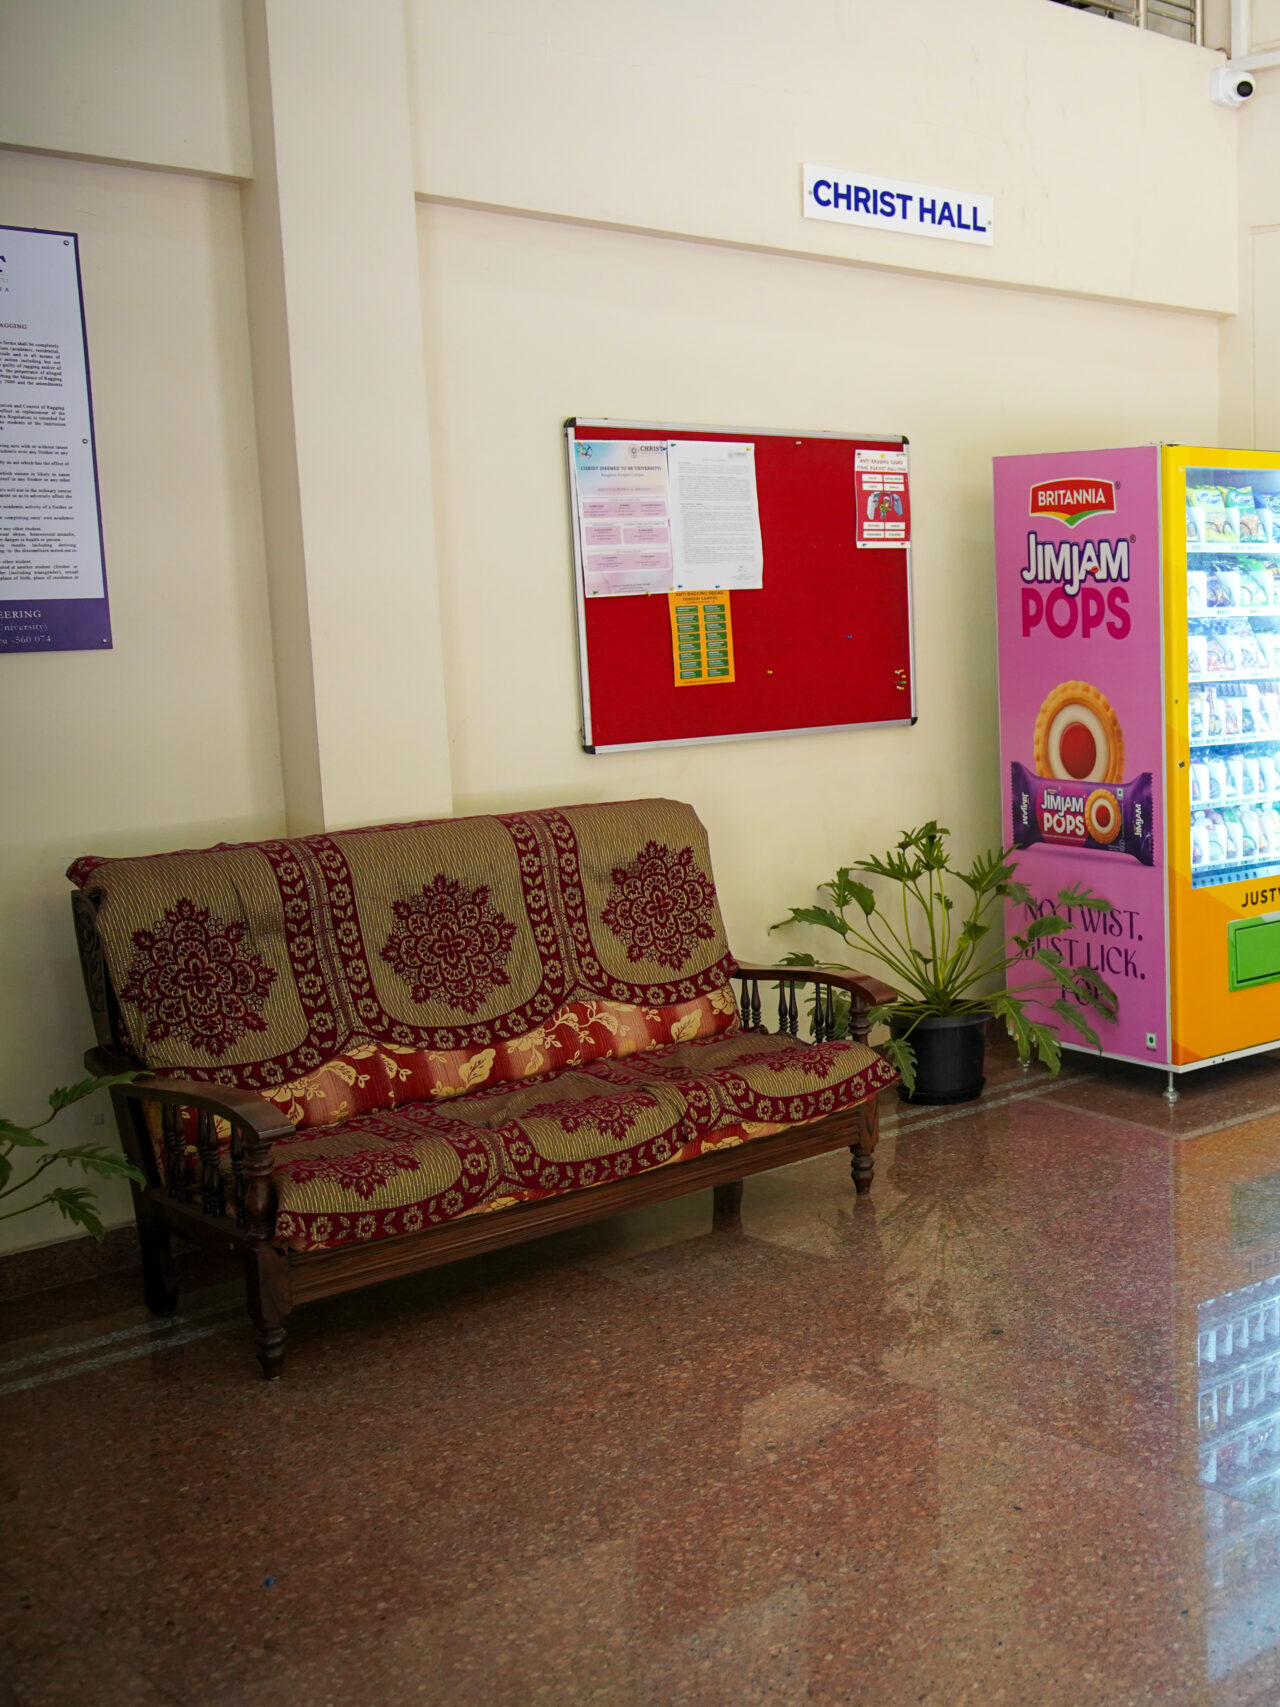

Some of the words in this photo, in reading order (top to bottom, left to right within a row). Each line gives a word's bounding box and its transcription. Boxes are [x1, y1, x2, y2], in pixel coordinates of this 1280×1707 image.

[813, 180, 913, 220] CHRIST
[919, 197, 986, 232] HALL
[1038, 488, 1106, 506] BRITANNIA
[1021, 531, 1129, 596] JIMJAM
[0, 624, 47, 632] niversity)
[1021, 586, 1131, 640] POPS
[1041, 789, 1084, 817] JIMJAM
[1043, 812, 1085, 836] POPS
[1087, 942, 1146, 980] LICK.
